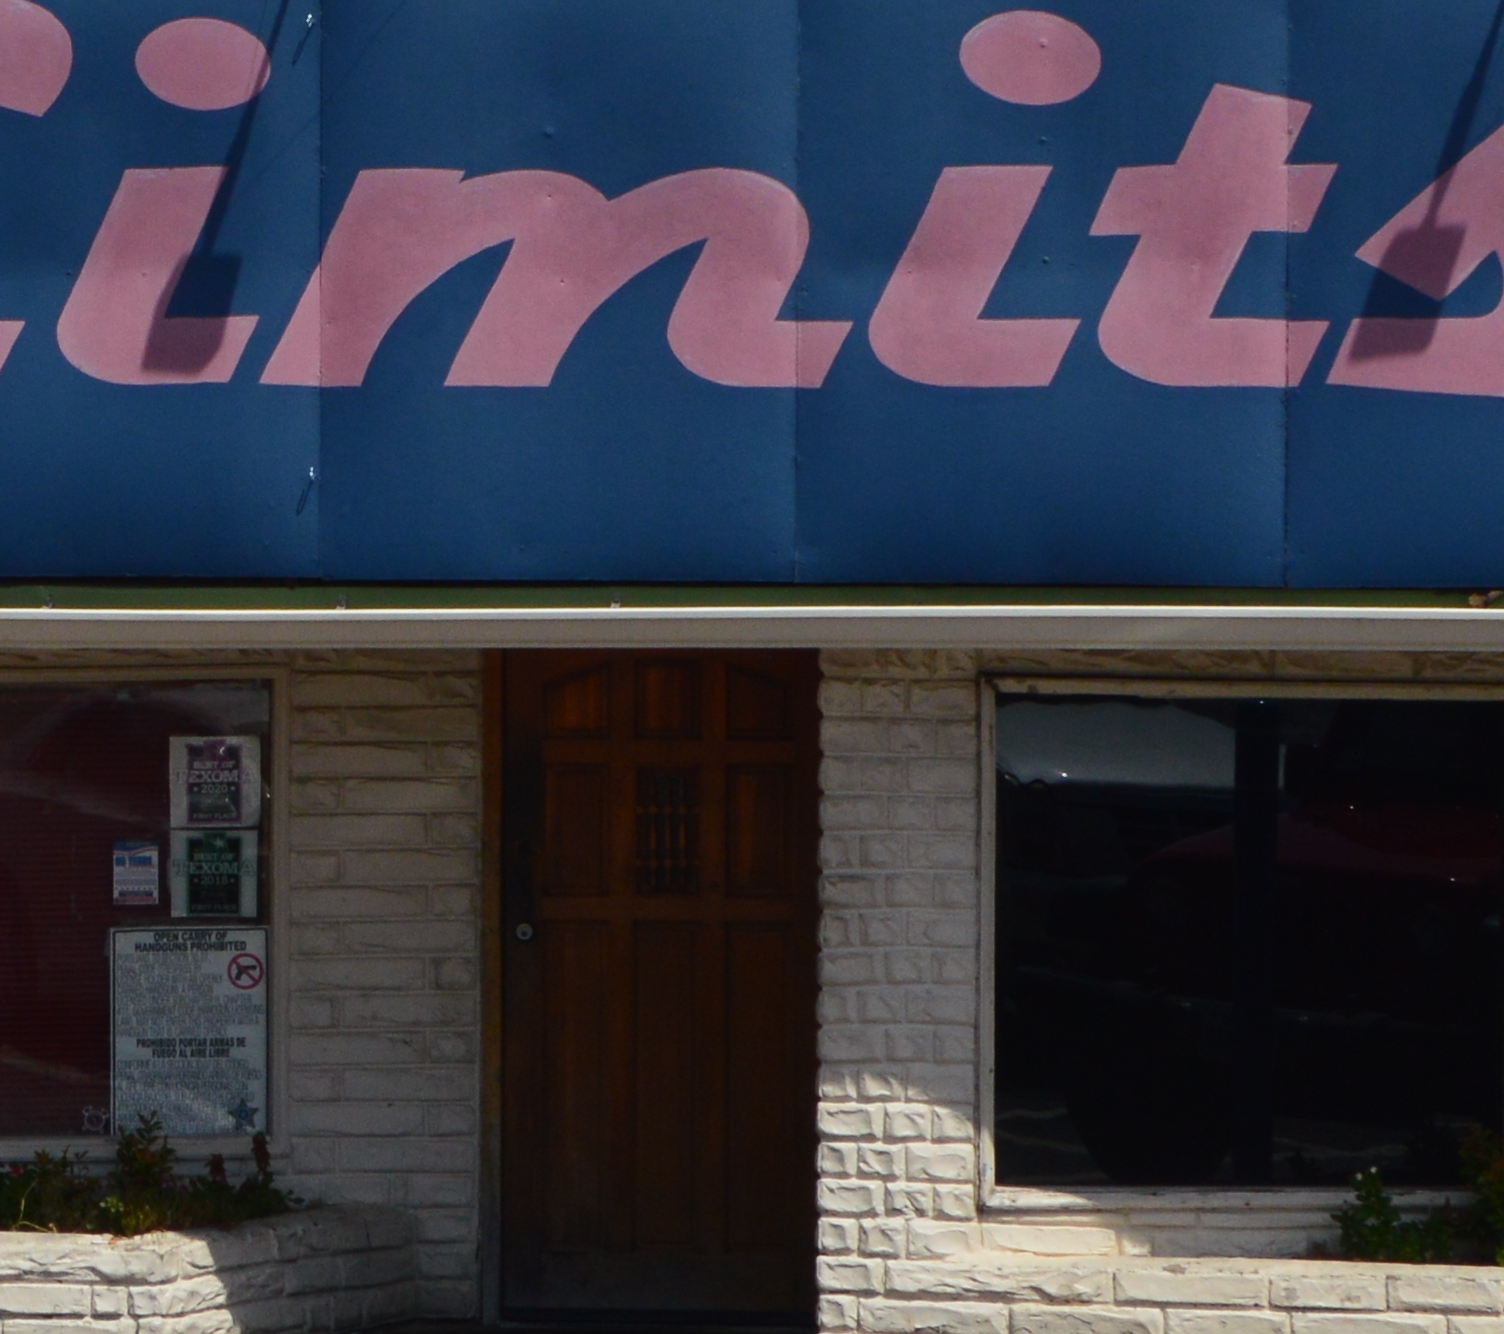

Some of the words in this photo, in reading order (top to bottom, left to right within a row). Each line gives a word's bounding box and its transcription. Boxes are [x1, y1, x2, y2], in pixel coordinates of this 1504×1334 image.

[174, 769, 255, 784] TEXOMA
[200, 784, 228, 793] 2020
[173, 861, 256, 875] TEXOMA
[200, 875, 228, 885] 2018
[154, 932, 179, 942] OPEN
[182, 931, 213, 941] CARRY
[216, 931, 228, 940] OF
[135, 942, 188, 952] HANDGUNS
[191, 941, 247, 951] PROHIBITED
[137, 1038, 177, 1048] PROHIBIDO
[178, 1038, 207, 1047] PORTAR
[209, 1038, 235, 1047] ARMAS
[236, 1037, 246, 1047] DE
[152, 1049, 177, 1058] FUEGO
[179, 1049, 188, 1058] AL
[190, 1049, 206, 1058] AIRE
[209, 1049, 230, 1057] LIBRE
